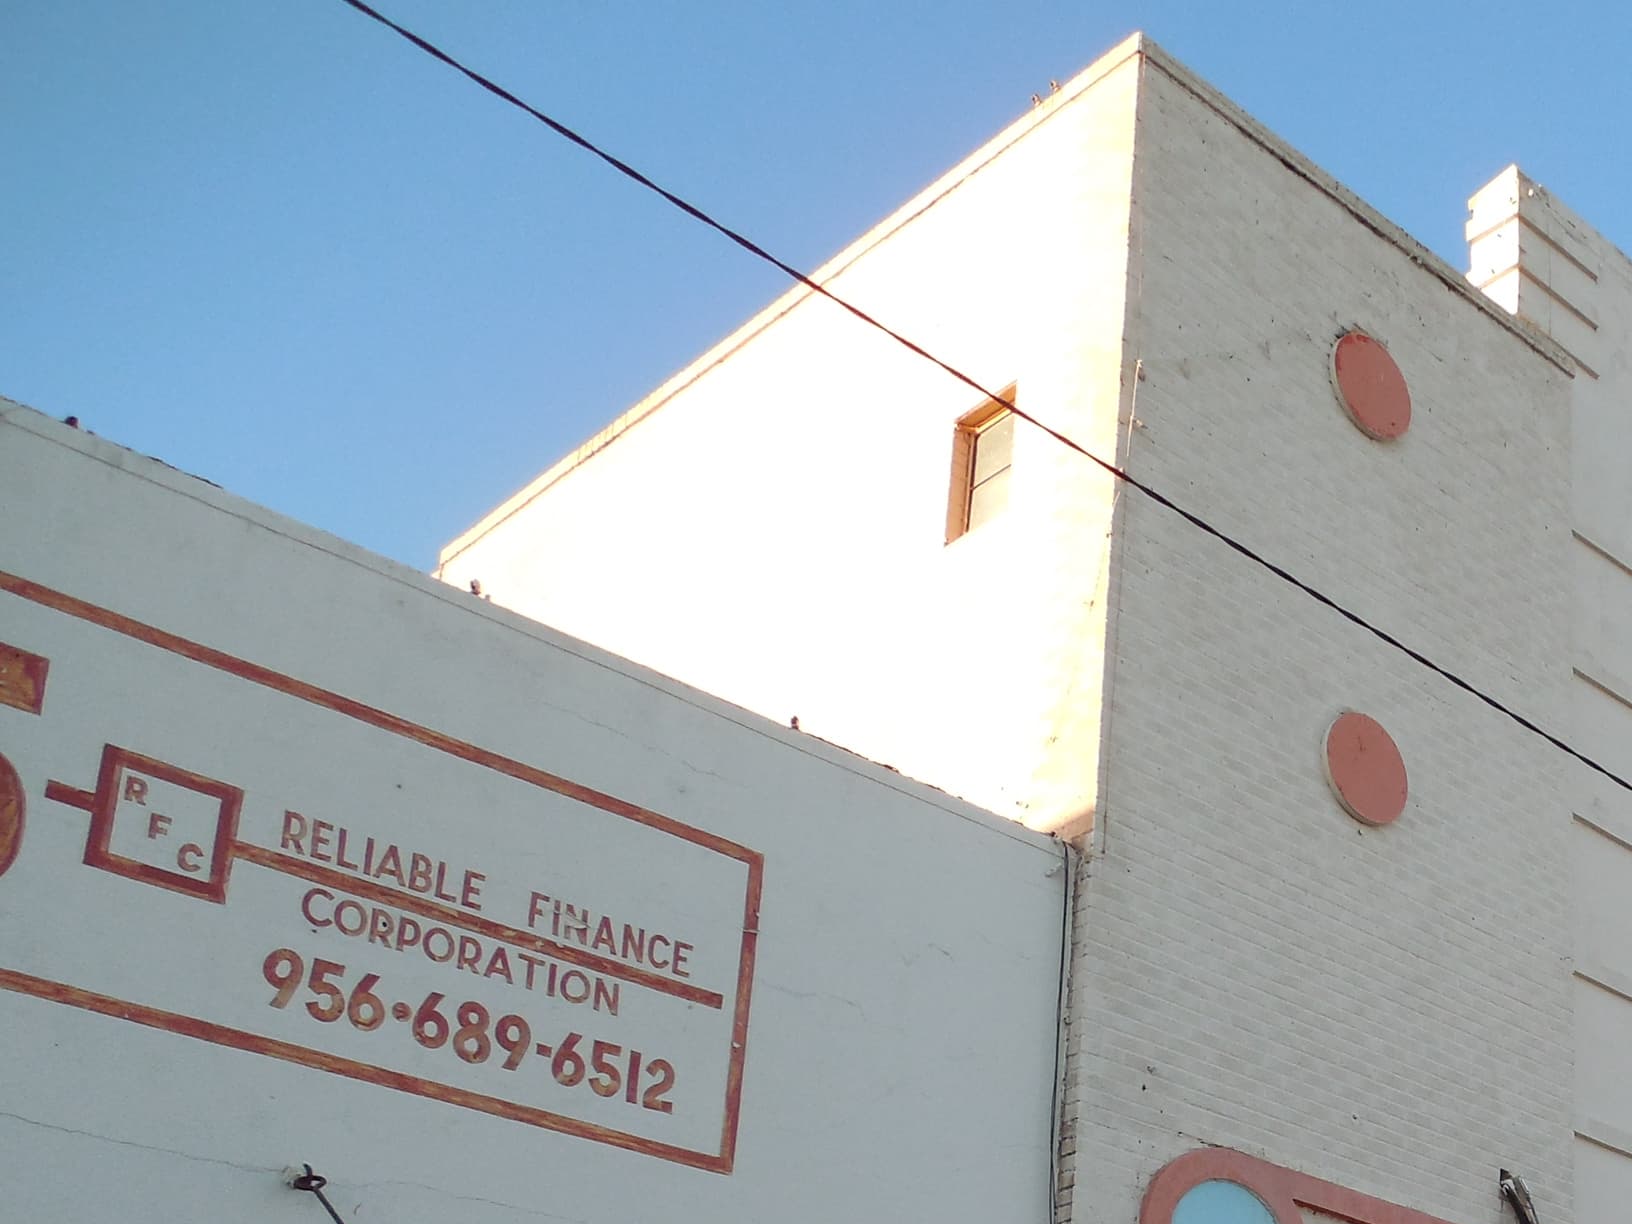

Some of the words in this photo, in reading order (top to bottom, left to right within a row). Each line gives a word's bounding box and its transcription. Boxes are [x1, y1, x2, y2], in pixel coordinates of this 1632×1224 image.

[279, 809, 486, 911] RELIABLE
[527, 891, 694, 978] FINANCE
[300, 887, 620, 1017] CORPORATION
